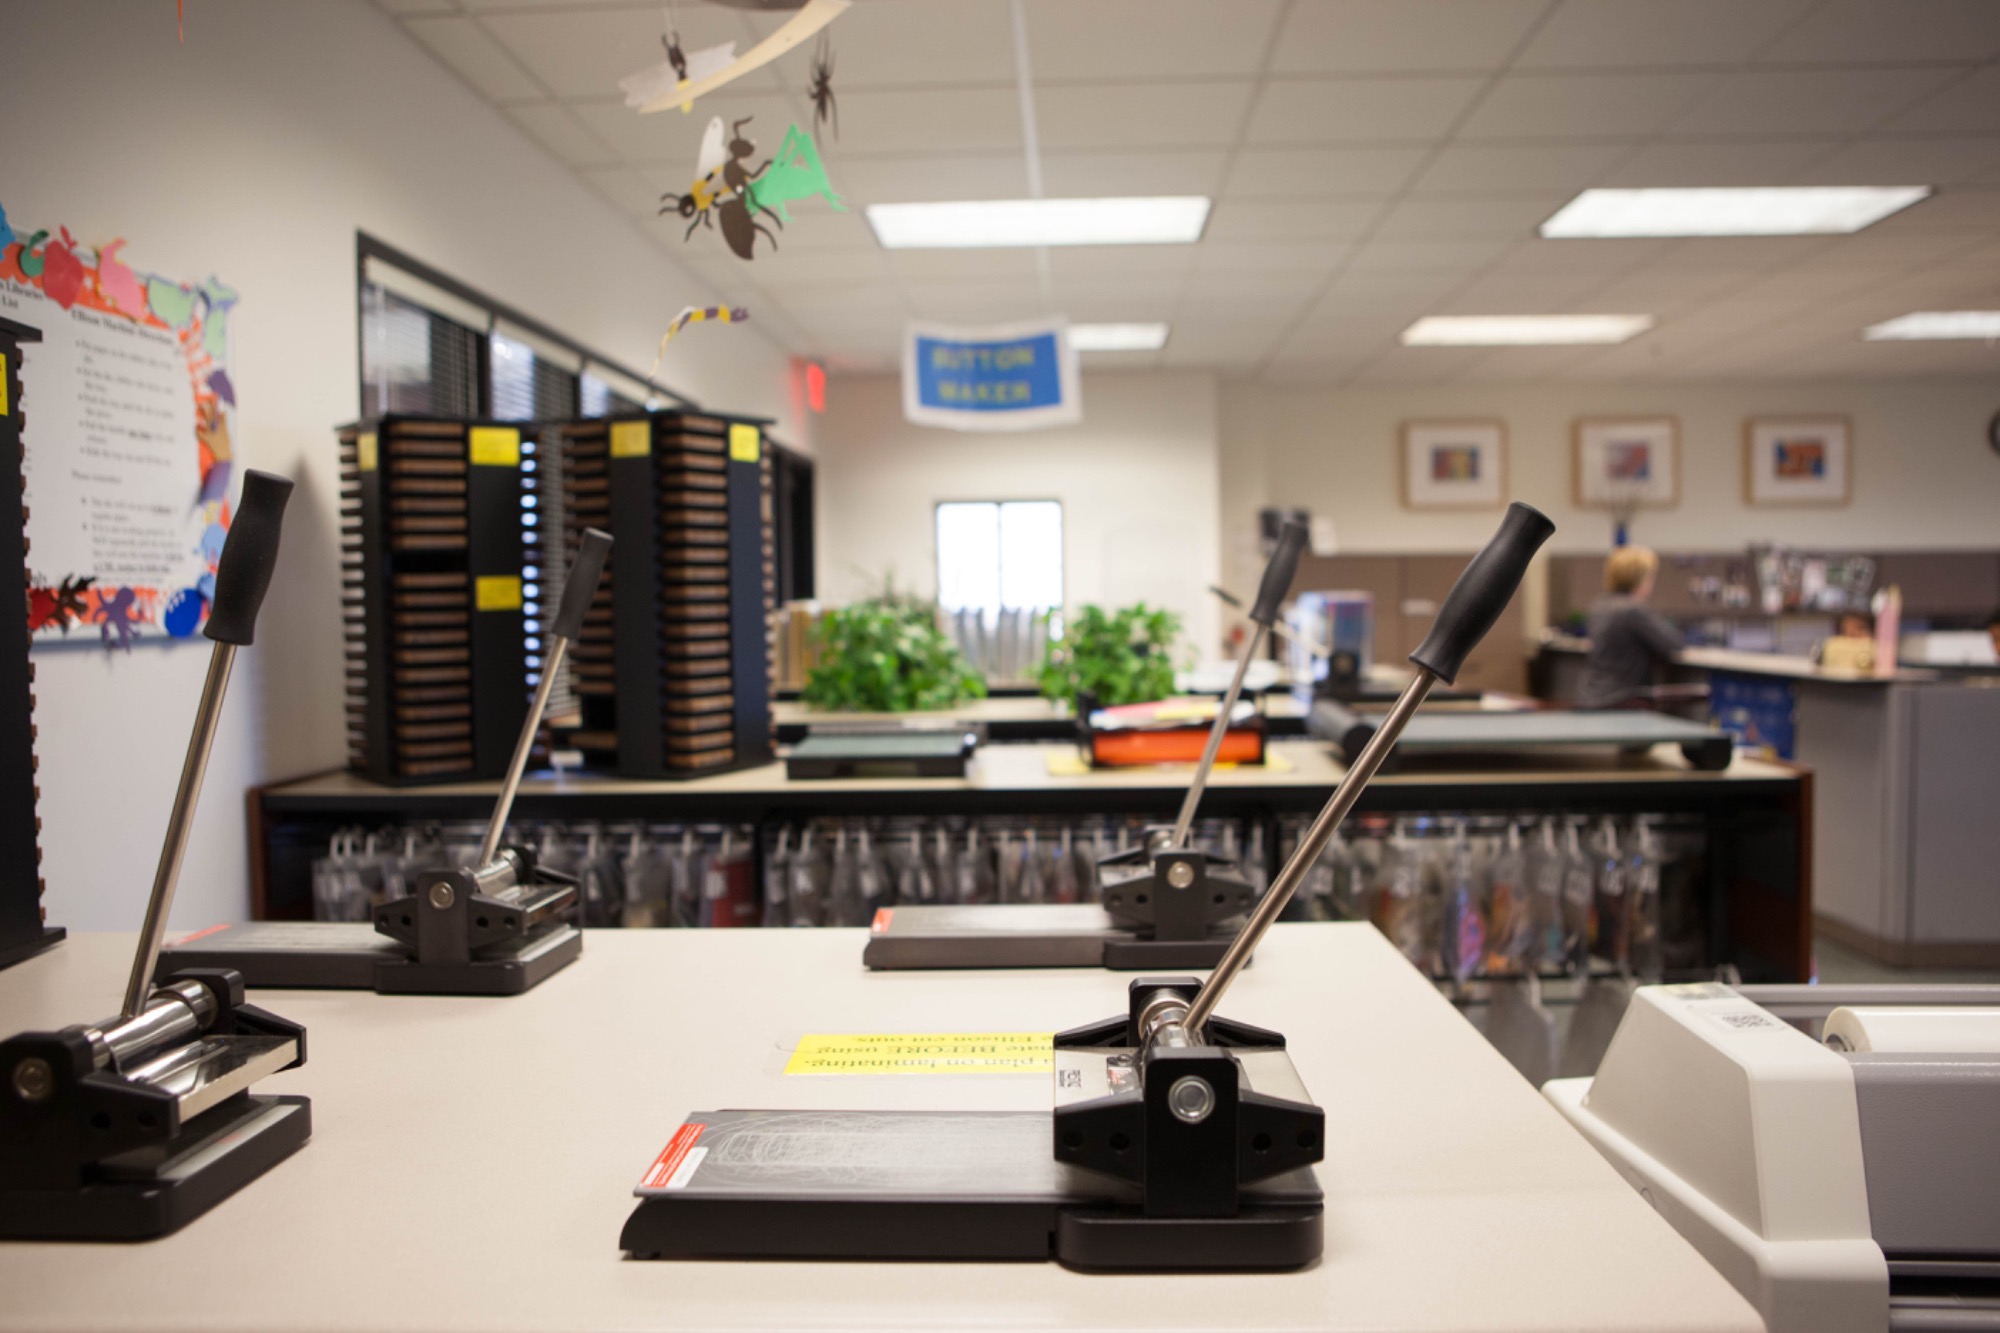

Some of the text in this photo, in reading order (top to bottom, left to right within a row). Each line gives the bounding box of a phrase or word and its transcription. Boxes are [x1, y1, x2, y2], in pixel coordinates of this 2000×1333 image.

[932, 347, 1035, 370] BUTTON
[938, 380, 1031, 403] MAKER
[817, 1046, 878, 1055] using
[887, 1045, 996, 1053] BEFORE
[984, 1056, 1033, 1068] plan
